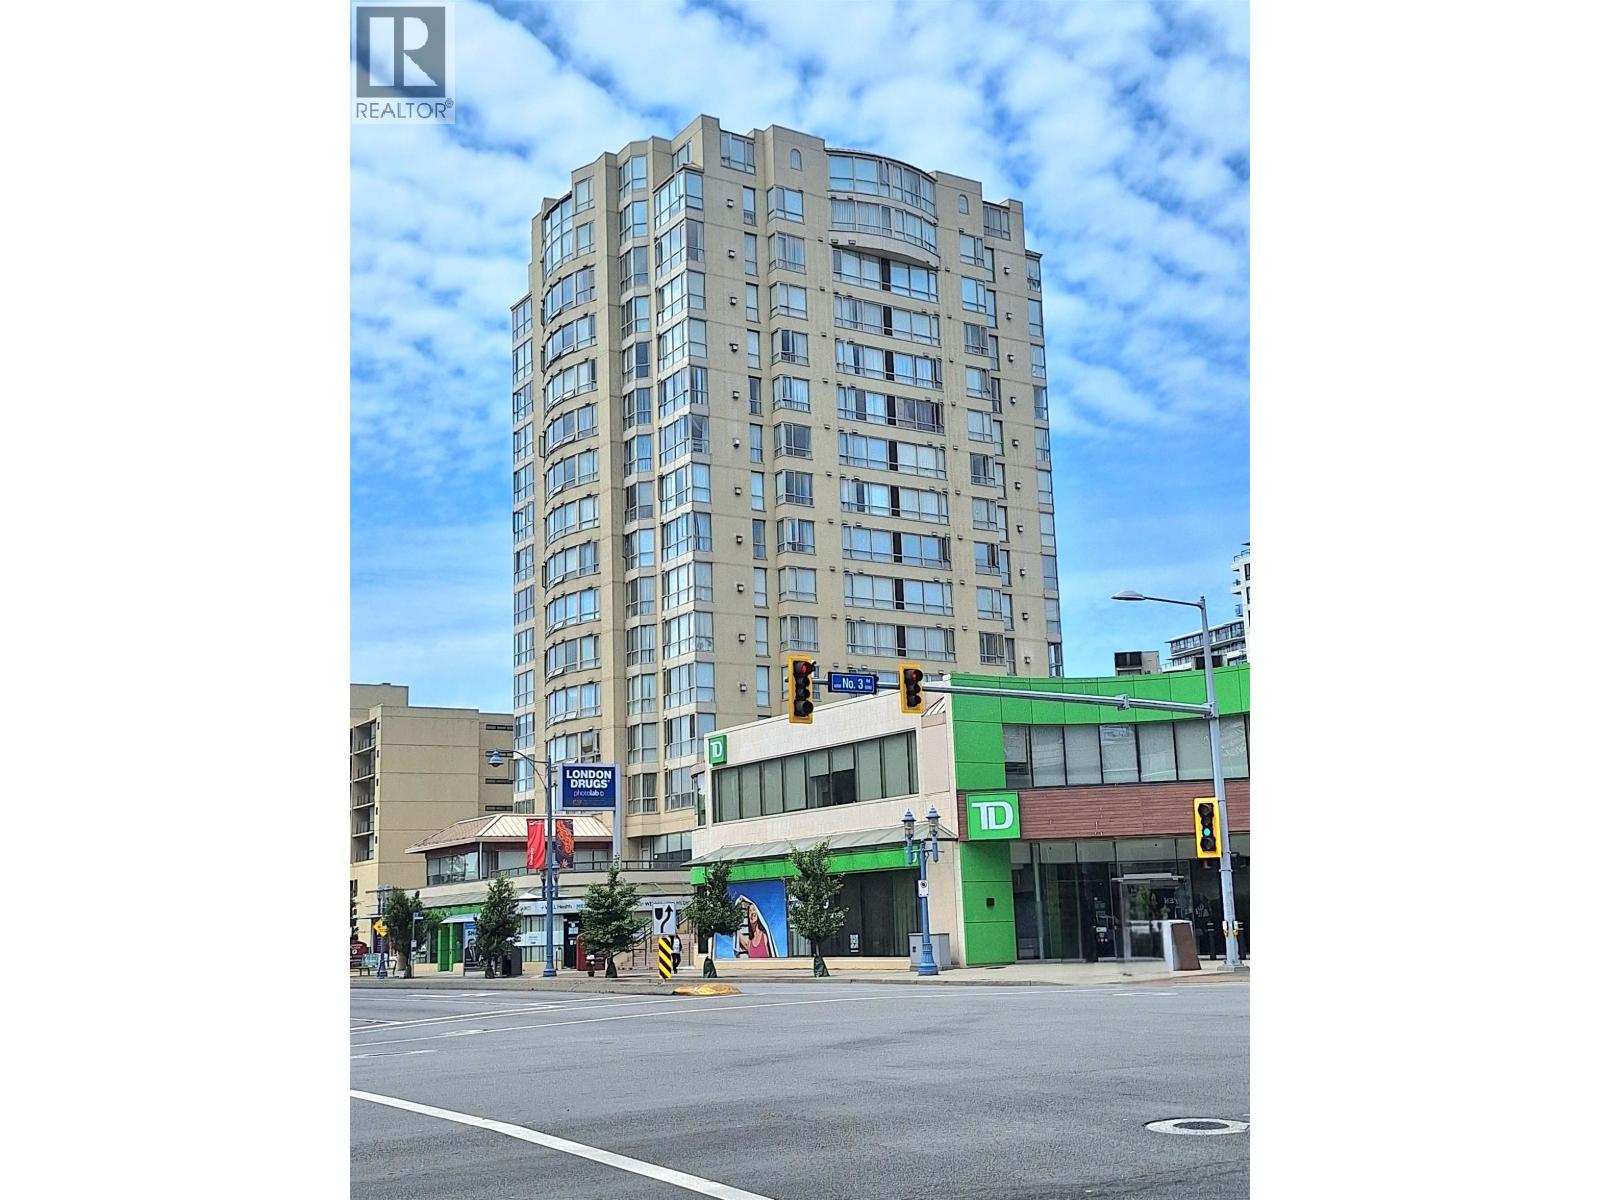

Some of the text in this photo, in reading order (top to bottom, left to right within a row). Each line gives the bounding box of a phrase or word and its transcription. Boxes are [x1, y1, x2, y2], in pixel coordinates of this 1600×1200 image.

[842, 677, 856, 689] No.
[857, 678, 864, 690] 3
[710, 741, 723, 758] TD
[566, 769, 612, 779] LONDON
[971, 801, 1014, 830] TD
